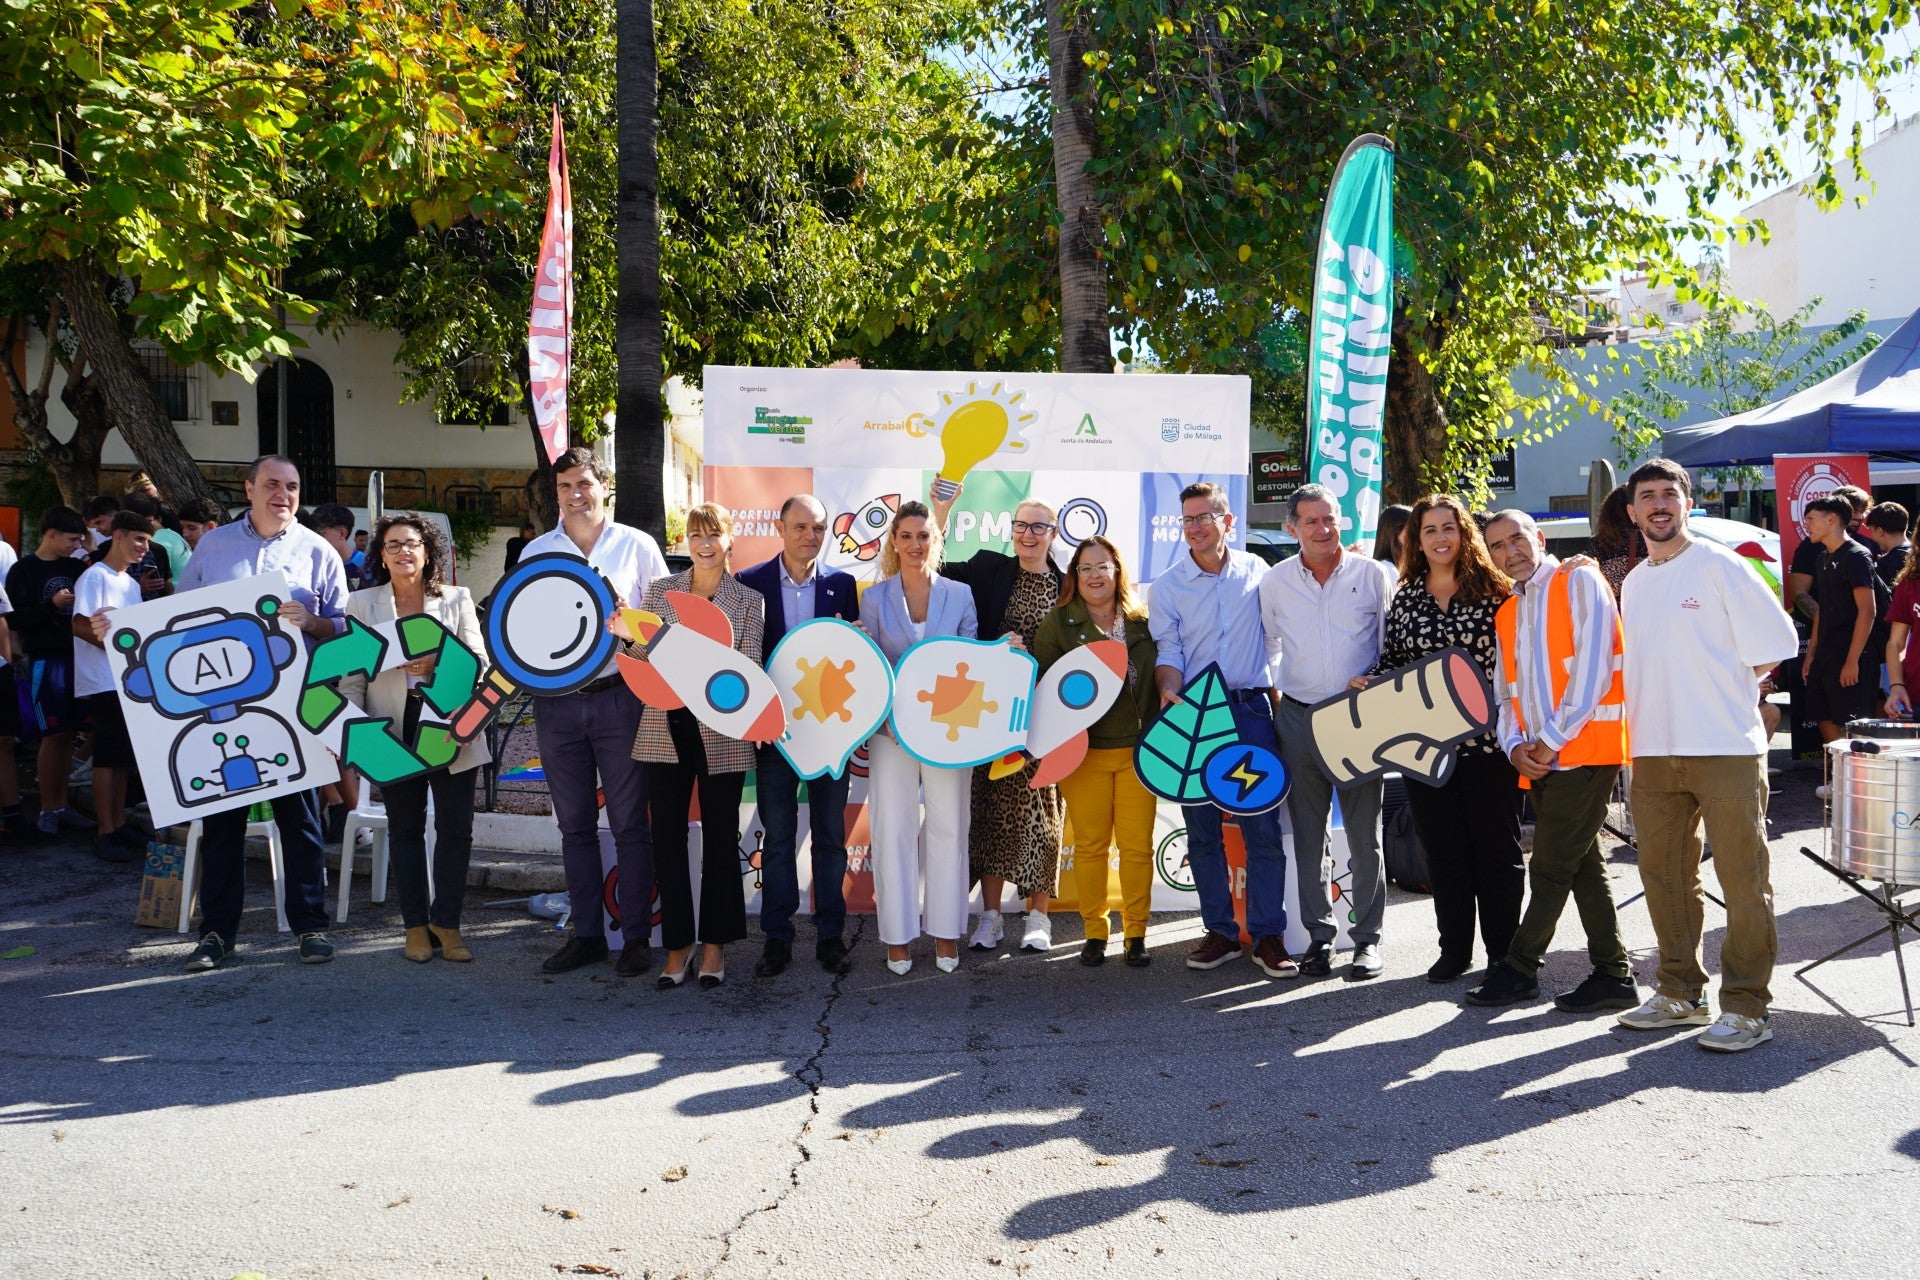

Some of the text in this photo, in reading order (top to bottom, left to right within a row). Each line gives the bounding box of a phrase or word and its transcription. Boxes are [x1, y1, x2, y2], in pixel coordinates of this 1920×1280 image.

[1318, 230, 1353, 531] ORTUNITY
[768, 423, 804, 434] Verdes
[863, 420, 905, 431] Arrabal
[1195, 432, 1222, 441] Málaga
[1261, 462, 1301, 472] GOME
[1257, 482, 1296, 491] GESTORÍA
[1805, 491, 1831, 502] COST
[729, 509, 781, 520] PORTUN
[733, 522, 780, 537] ORNI
[195, 647, 233, 685] AI
